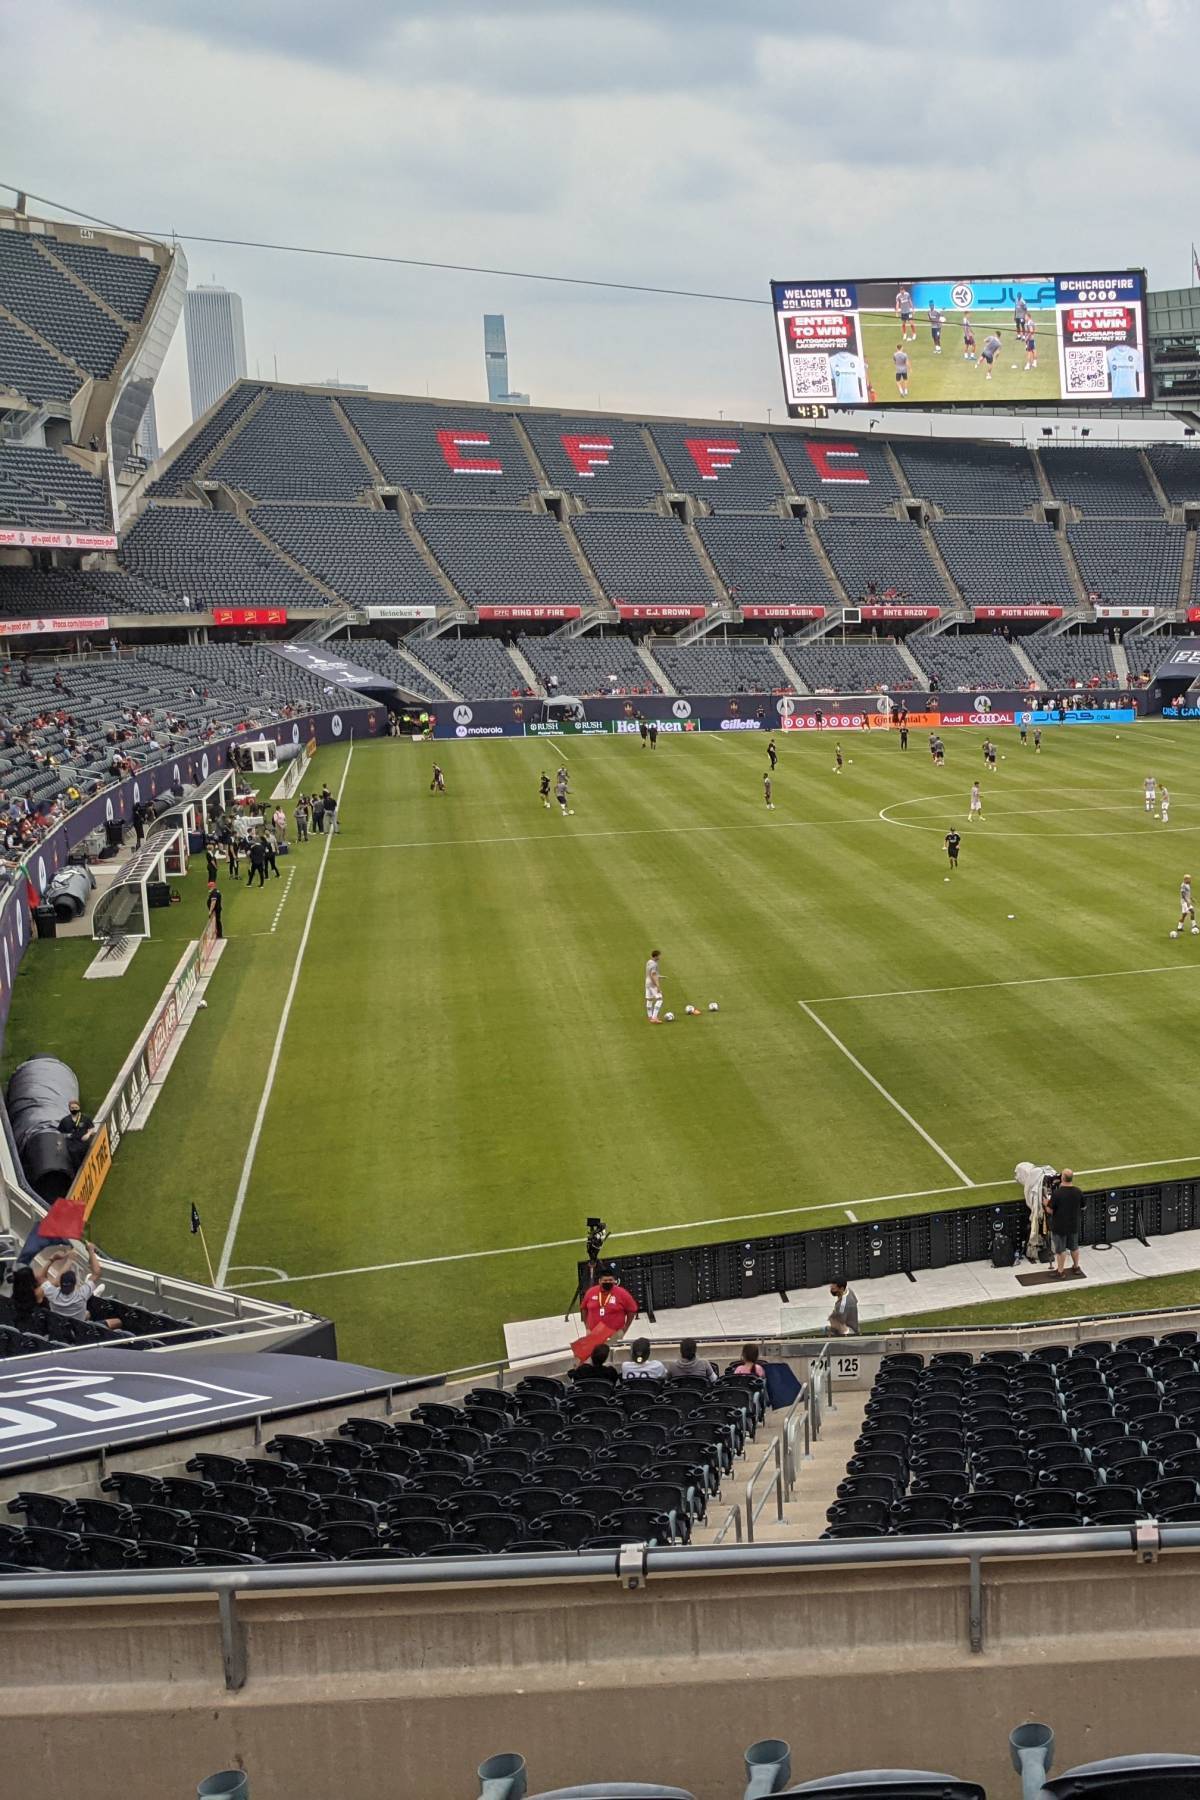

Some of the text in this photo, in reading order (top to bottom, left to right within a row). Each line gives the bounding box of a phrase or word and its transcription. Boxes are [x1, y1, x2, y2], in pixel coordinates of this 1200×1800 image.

[1060, 279, 1134, 290] @CHICAGOFIRE
[785, 288, 847, 299] WELCOME TO
[782, 299, 852, 309] SOLDIER FIELD
[1073, 309, 1124, 318] ENTER
[795, 317, 843, 326] ENTER
[1071, 318, 1127, 329] TO WIN
[794, 326, 847, 336] TO WIN
[797, 405, 827, 418] 4:37
[720, 718, 761, 730] Gillette
[942, 715, 964, 723] Audi
[468, 726, 503, 735] motorola
[837, 1358, 859, 1372] 125
